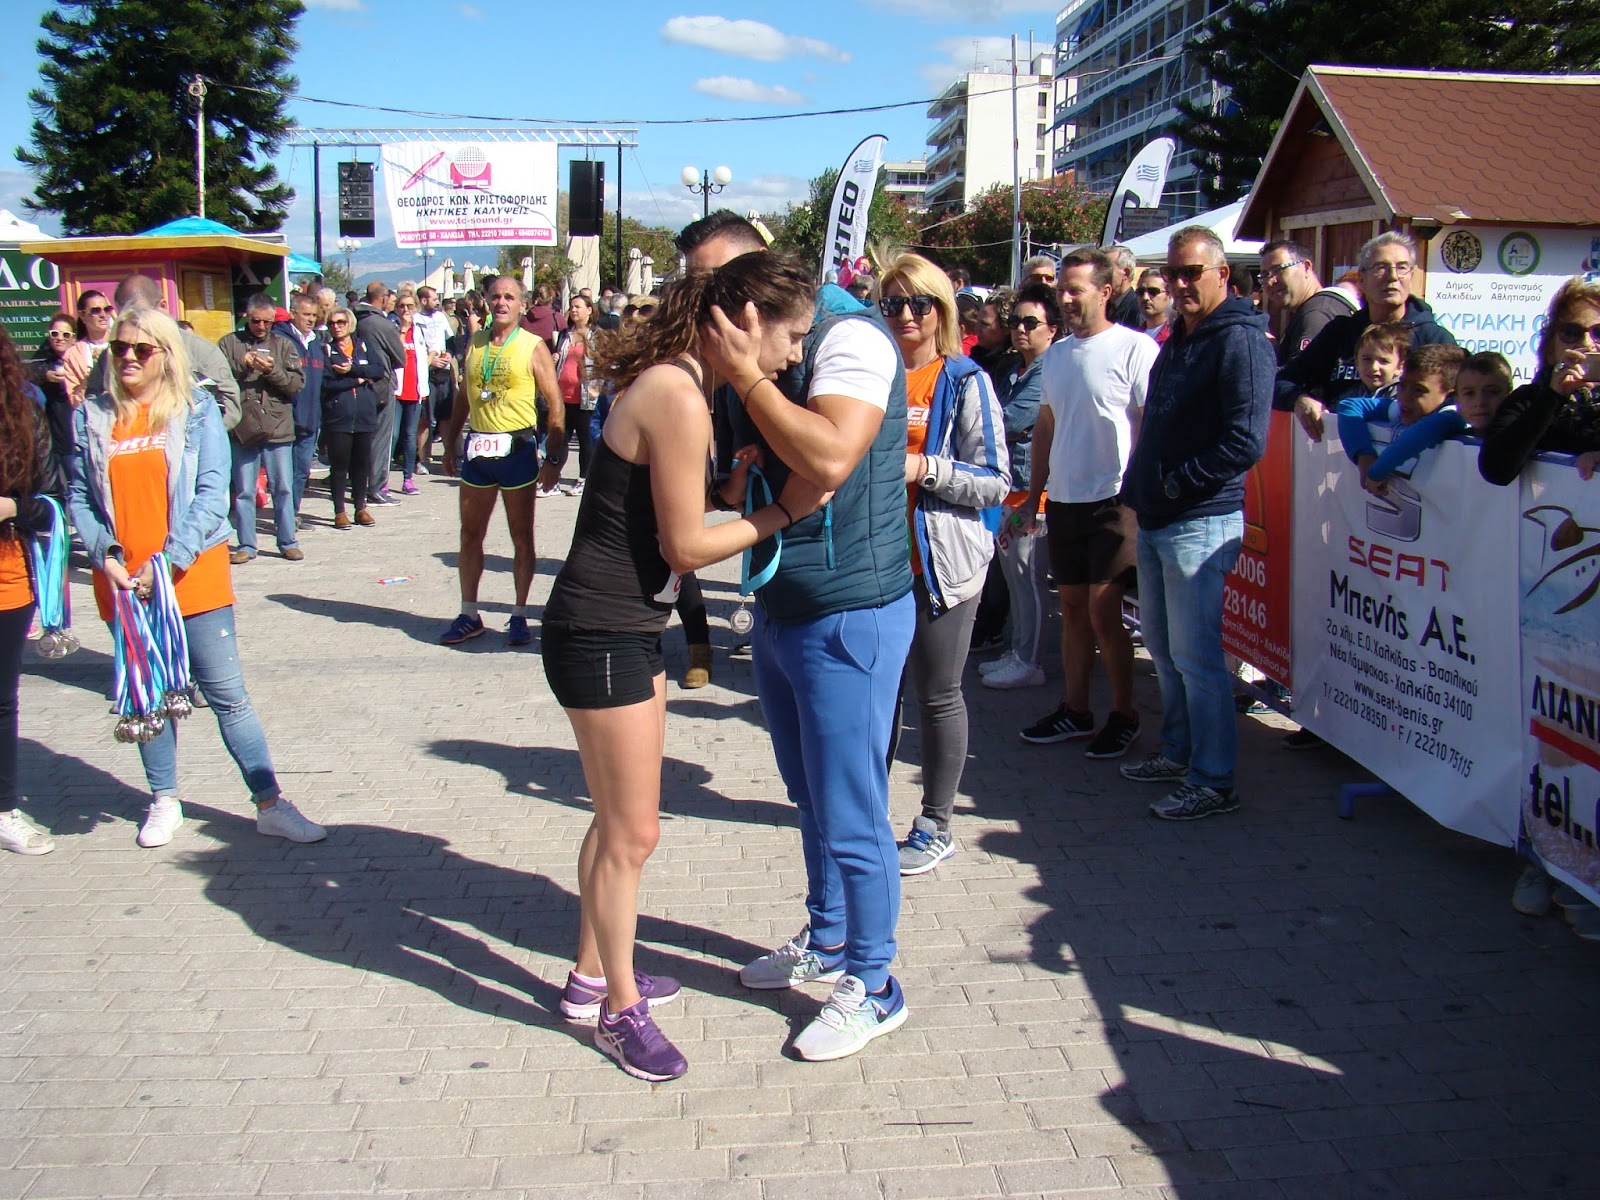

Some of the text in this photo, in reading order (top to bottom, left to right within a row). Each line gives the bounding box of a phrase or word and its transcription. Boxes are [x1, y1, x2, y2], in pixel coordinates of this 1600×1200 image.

[397, 194, 548, 208] ΘΕΟΔΩΡΟΣ ΚΩΝ. ΧΡΙΣΤΟΦΟΡΙΔΗΣ
[416, 206, 530, 218] ΗΧΗΤΙΚΕΣ ΚΑΛΥΨΕΙΣ
[429, 216, 514, 226] www.tc-sound.gr
[1445, 280, 1474, 291] Δήμος
[1490, 281, 1543, 292] Οργανισμός
[1435, 291, 1482, 301] Χαλκιδέων
[1490, 292, 1541, 303] Αθλητισμού
[1433, 312, 1526, 332] ΚΥΡΙΑΚΗ
[474, 438, 499, 452] 601
[1348, 535, 1450, 593] SEAT
[1223, 584, 1267, 630] 28146
[1330, 569, 1476, 665] Μπενής Α.Ε.
[1329, 642, 1347, 663] Νέα
[1395, 673, 1441, 705] Χαλκίδα
[1442, 691, 1473, 721] 34100
[1428, 660, 1478, 697] Βασιλικού
[1354, 679, 1443, 735] www.seat-benis.gr
[1334, 688, 1359, 715] 22210
[1360, 702, 1387, 731] 28350
[1414, 731, 1447, 761] 22210
[1448, 748, 1474, 779] 75115
